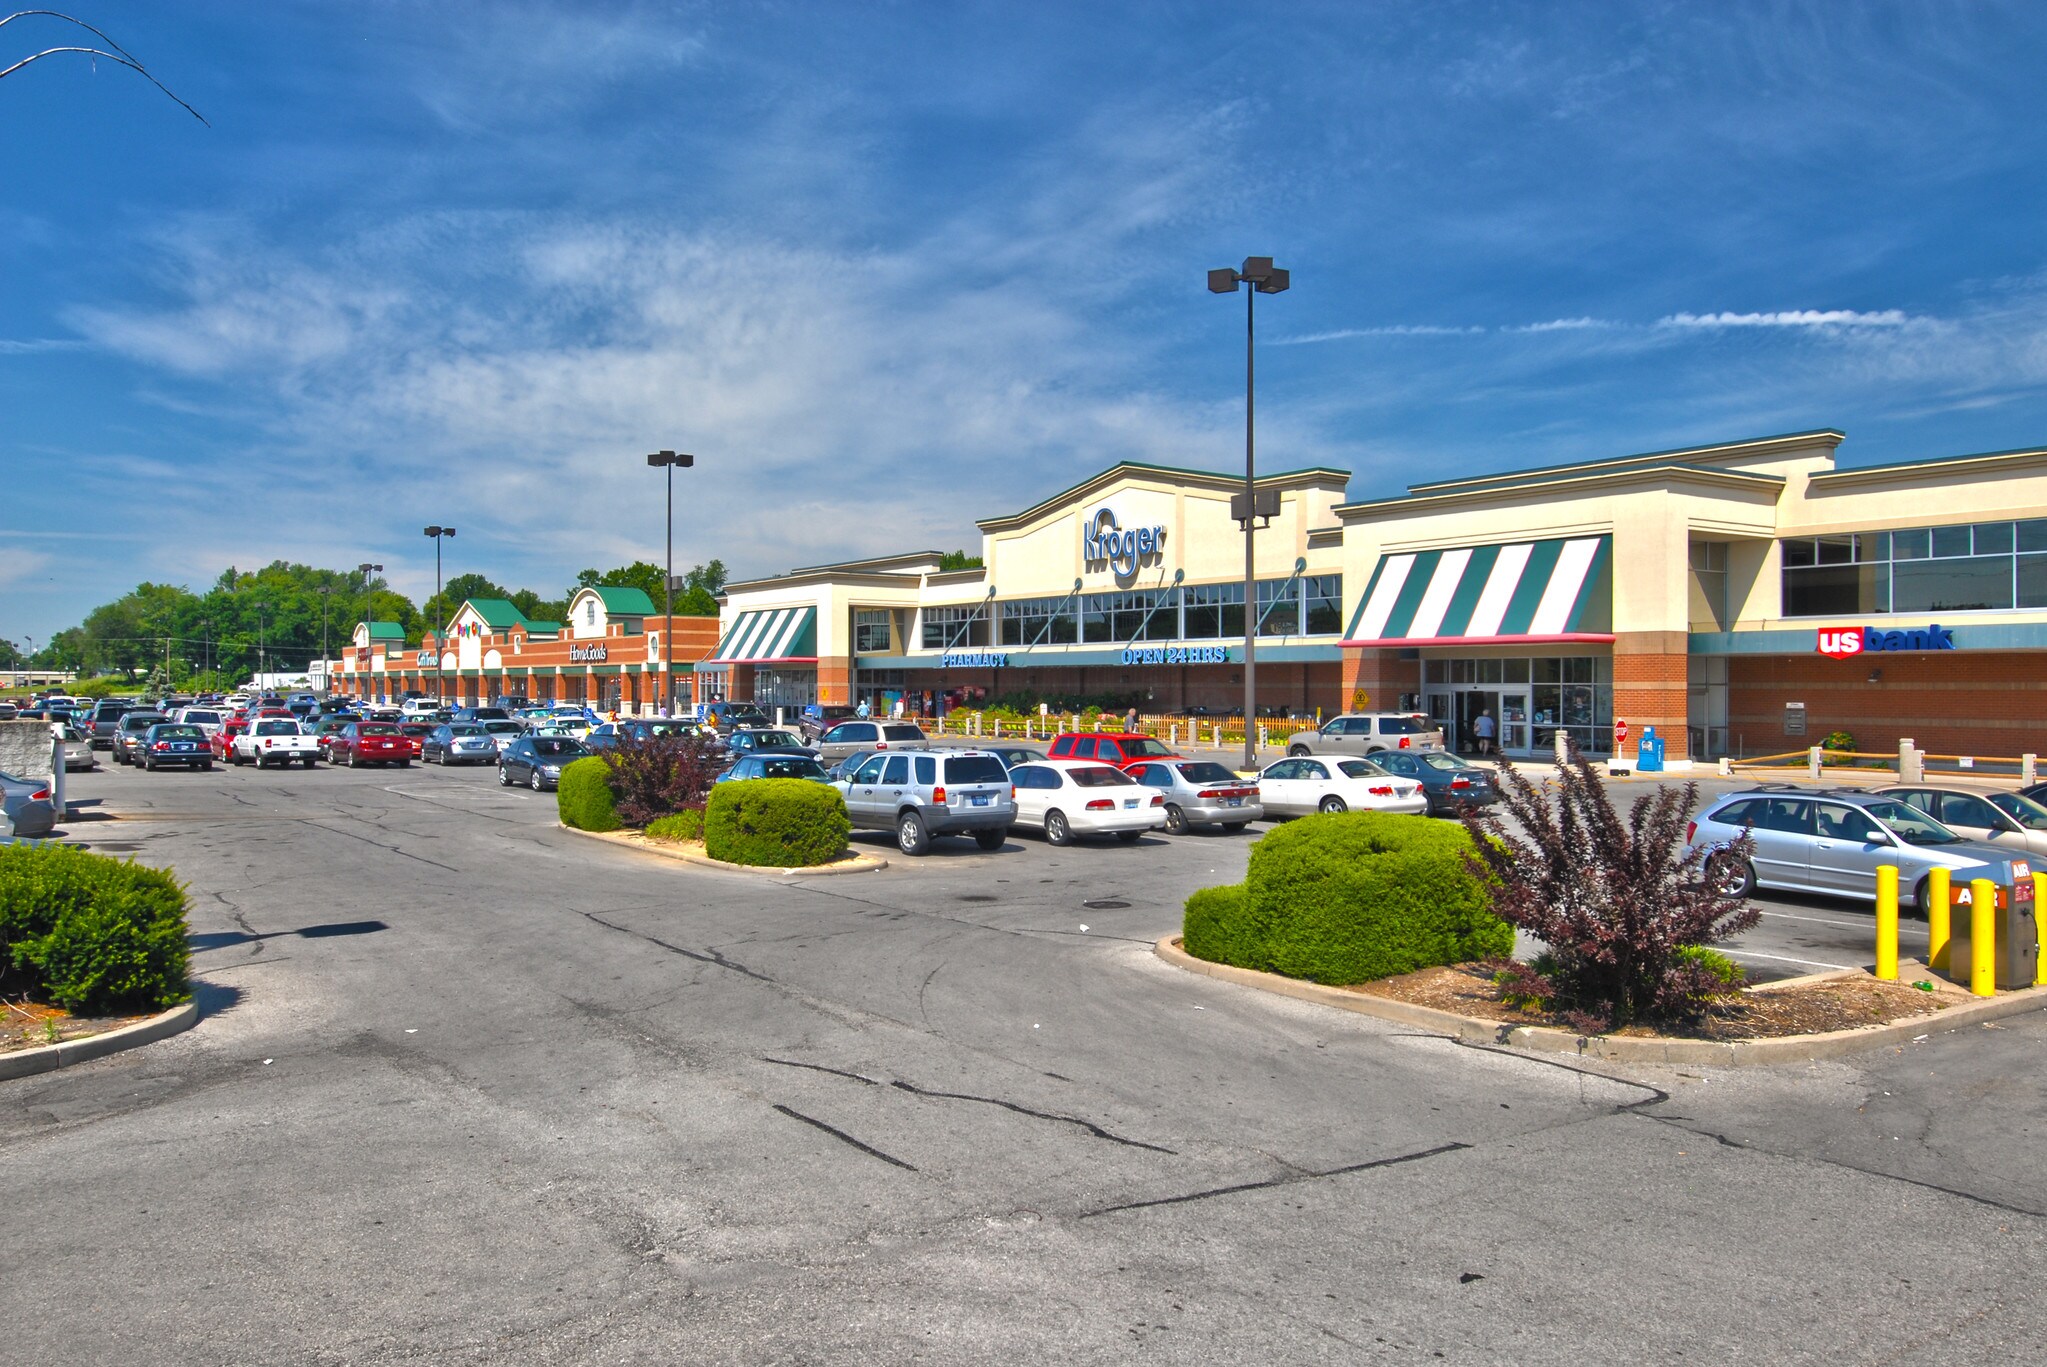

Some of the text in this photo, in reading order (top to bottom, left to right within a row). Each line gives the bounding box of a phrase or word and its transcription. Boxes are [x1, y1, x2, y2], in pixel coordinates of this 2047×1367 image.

[1084, 508, 1162, 577] Kroger
[1863, 624, 1956, 652] bank
[570, 642, 606, 660] HomeGoods
[941, 653, 1008, 667] PHARMACY
[1121, 646, 1226, 665] OPEN 24 HRS
[1615, 727, 1628, 737] STOP
[2013, 863, 2030, 878] AIR
